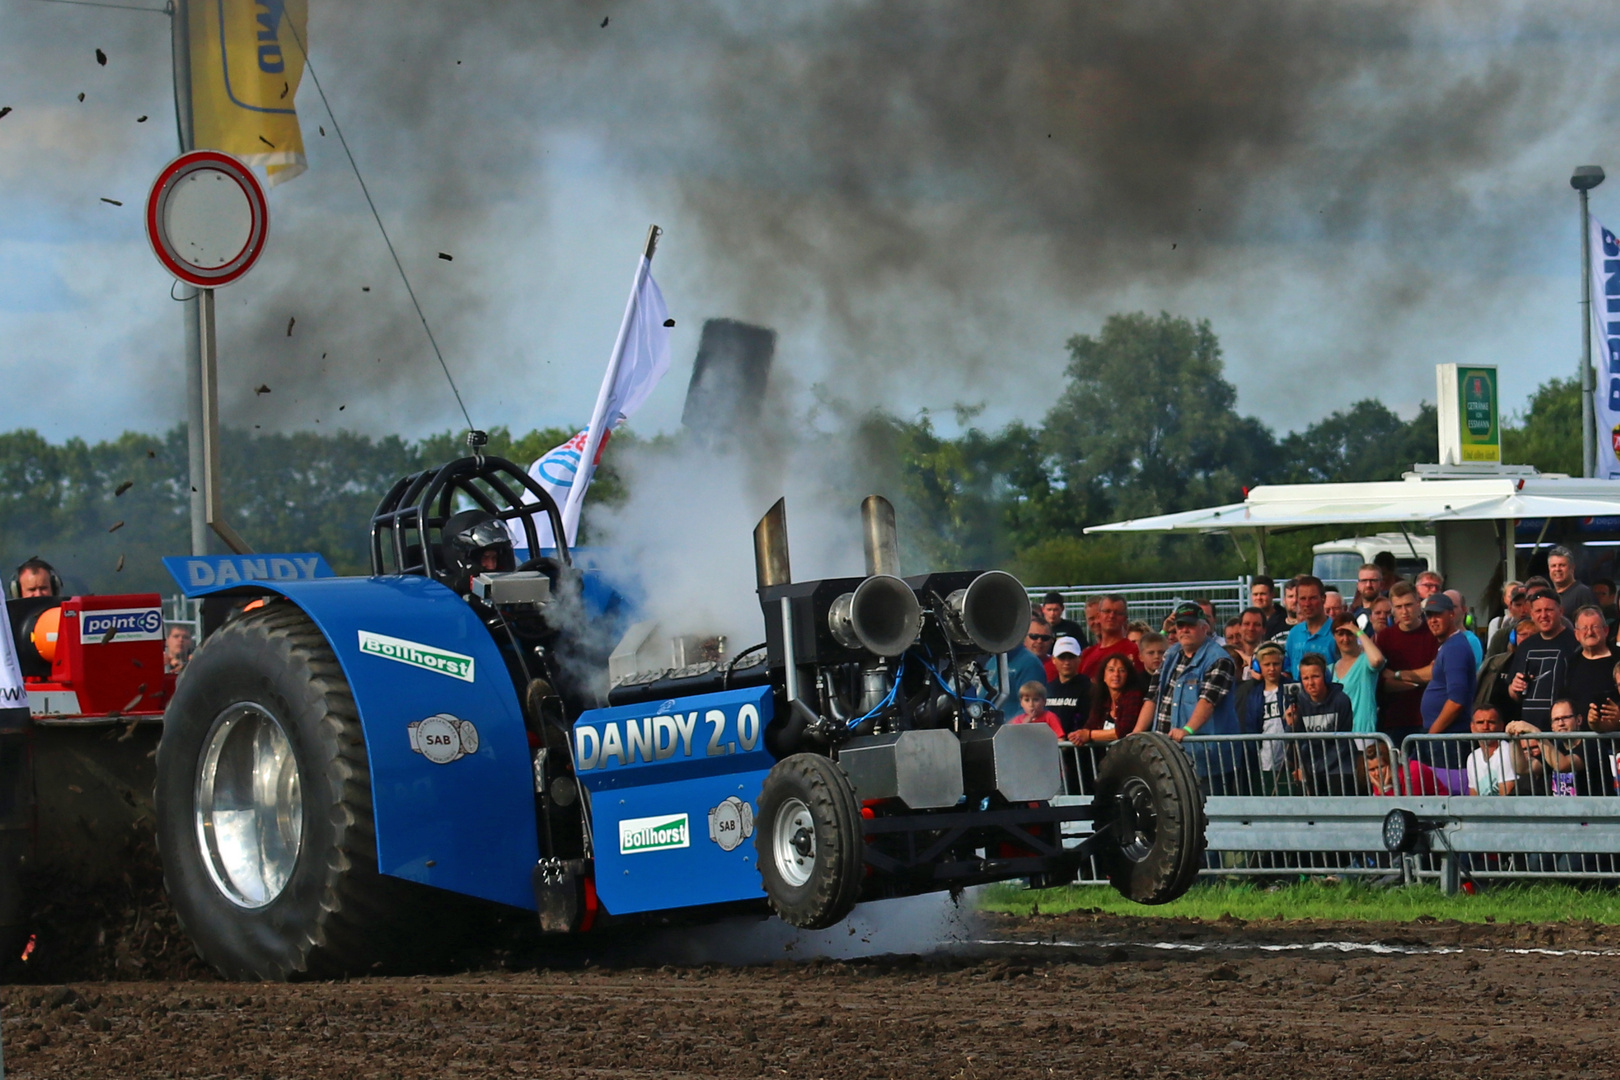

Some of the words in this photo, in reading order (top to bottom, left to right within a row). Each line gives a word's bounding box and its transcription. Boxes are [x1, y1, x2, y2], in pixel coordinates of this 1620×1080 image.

[187, 557, 318, 586] DANDY
[88, 616, 136, 633] point
[145, 613, 159, 630] S
[366, 638, 468, 676] Bollhorst
[426, 735, 451, 745] SAB
[575, 711, 699, 770] DANDY
[705, 703, 760, 756] 2.0
[624, 824, 685, 848] Bollhorst
[719, 820, 736, 832] SAB
